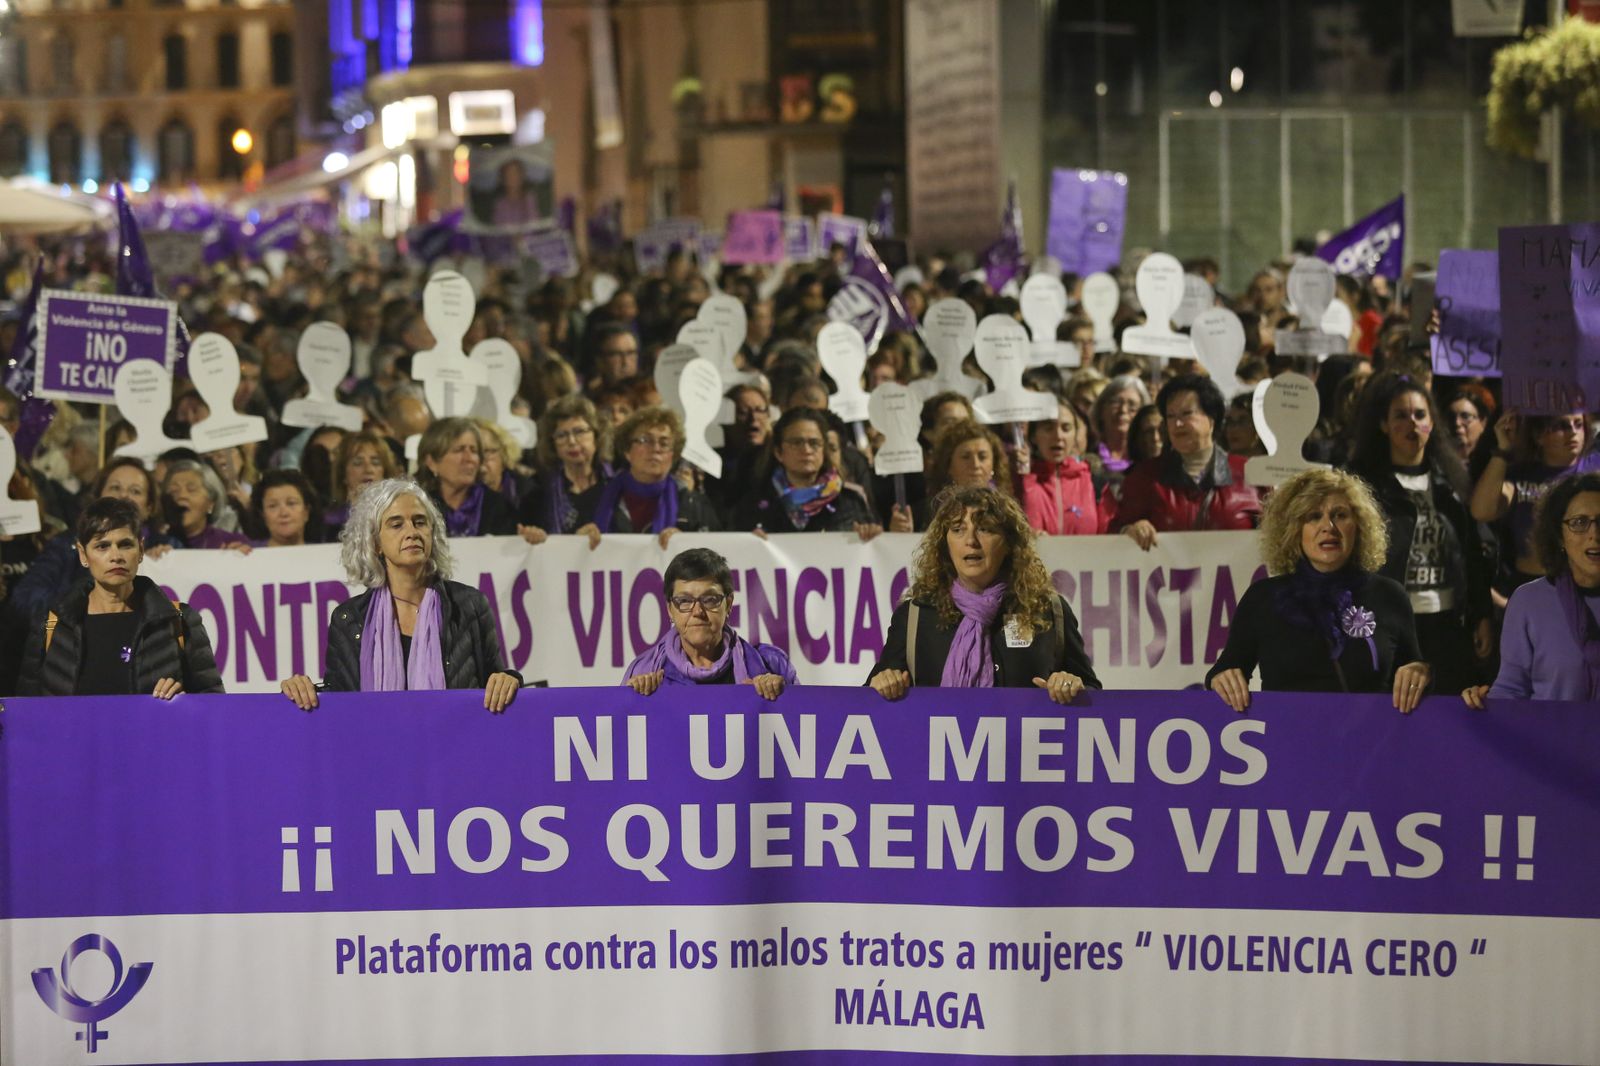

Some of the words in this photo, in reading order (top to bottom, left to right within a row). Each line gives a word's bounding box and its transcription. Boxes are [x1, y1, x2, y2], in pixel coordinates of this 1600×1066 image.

[51, 314, 103, 330] Violencia
[105, 319, 119, 331] de
[121, 320, 164, 335] Género
[87, 303, 115, 316] Ante
[117, 305, 127, 317] la
[85, 331, 127, 363] ¡NO
[59, 362, 81, 387] TE
[553, 714, 648, 782] NI
[688, 713, 892, 781] UNA
[928, 715, 1268, 786] MENOS
[280, 826, 334, 893] ¡¡
[375, 804, 570, 876] NOS
[605, 801, 1135, 882] QUEREMOS
[1168, 807, 1444, 879] VIVAS
[1483, 814, 1536, 881] !!
[336, 932, 532, 975] Plataforma
[545, 933, 656, 971] contra
[669, 929, 718, 970] los
[730, 926, 828, 969] malos
[840, 930, 945, 970] tratos
[956, 941, 975, 970] a
[988, 931, 1123, 983] mujeres
[1163, 934, 1353, 975] VIOLENCIA
[1365, 938, 1458, 978] CERO
[834, 978, 985, 1030] MÁLAGA
